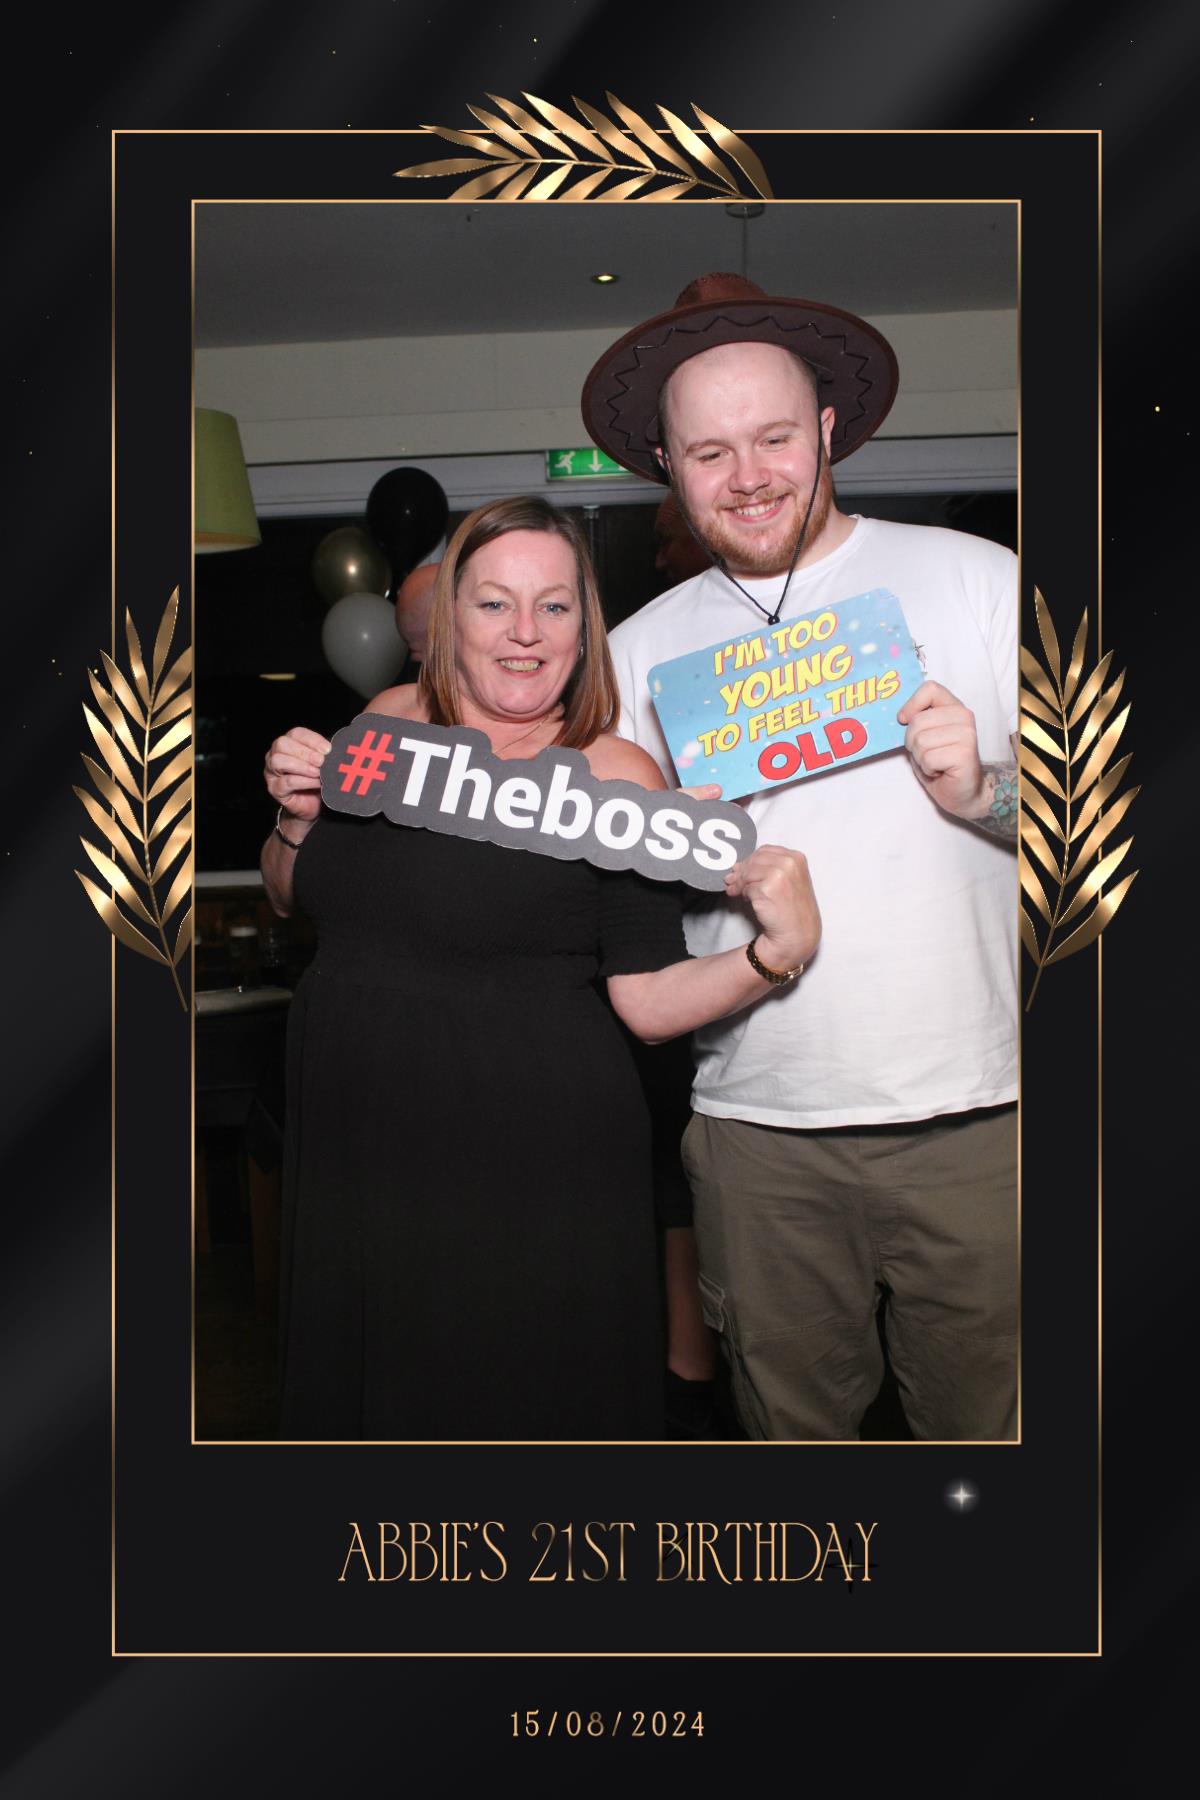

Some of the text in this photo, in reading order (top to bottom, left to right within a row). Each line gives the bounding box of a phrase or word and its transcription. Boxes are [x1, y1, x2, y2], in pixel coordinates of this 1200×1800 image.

[714, 611, 839, 677] I'M TOO
[719, 644, 854, 716] YOUNG
[696, 670, 901, 758] TO FEEL THIS
[757, 717, 868, 781] OLD
[338, 729, 742, 871] #Theboss
